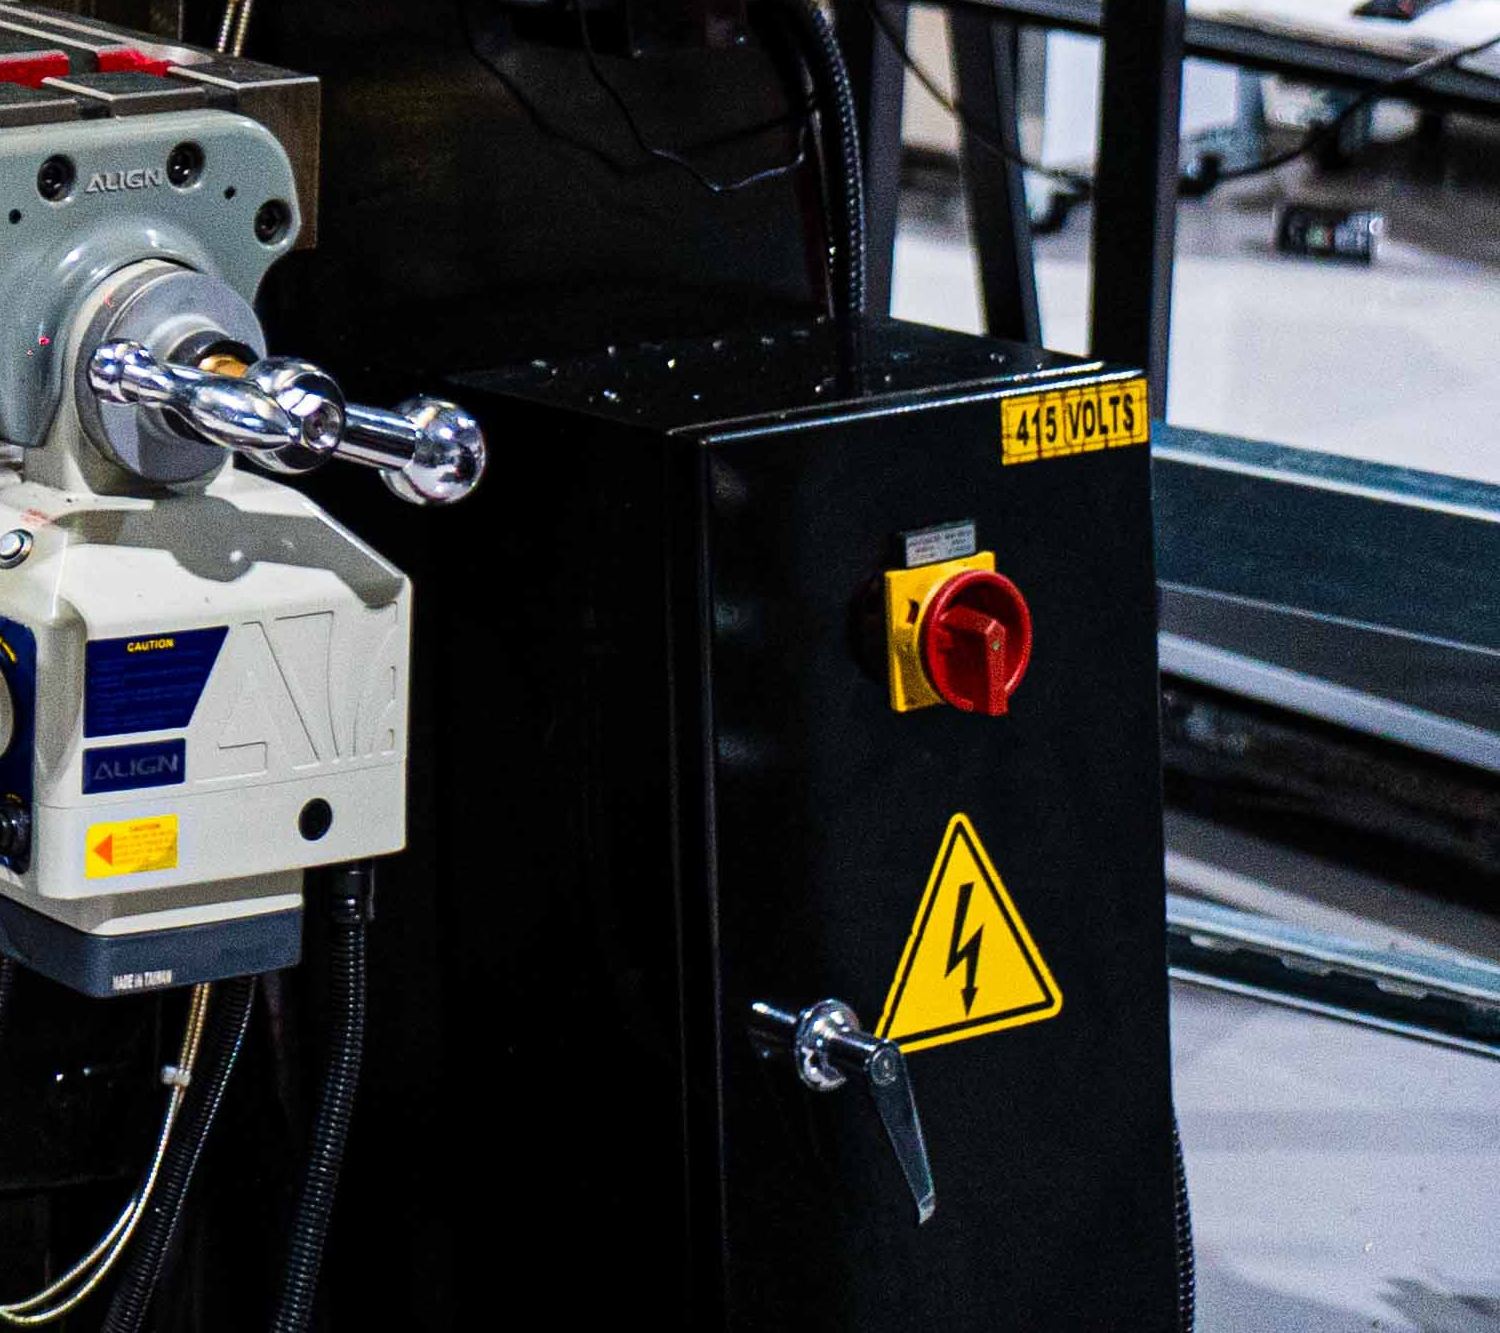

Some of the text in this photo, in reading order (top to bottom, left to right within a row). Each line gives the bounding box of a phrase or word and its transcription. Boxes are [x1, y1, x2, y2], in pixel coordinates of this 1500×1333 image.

[84, 168, 163, 193] ALIGN
[1016, 393, 1134, 446] 415 VOLTS
[127, 638, 175, 653] CAUTION
[93, 754, 178, 780] ALIGN
